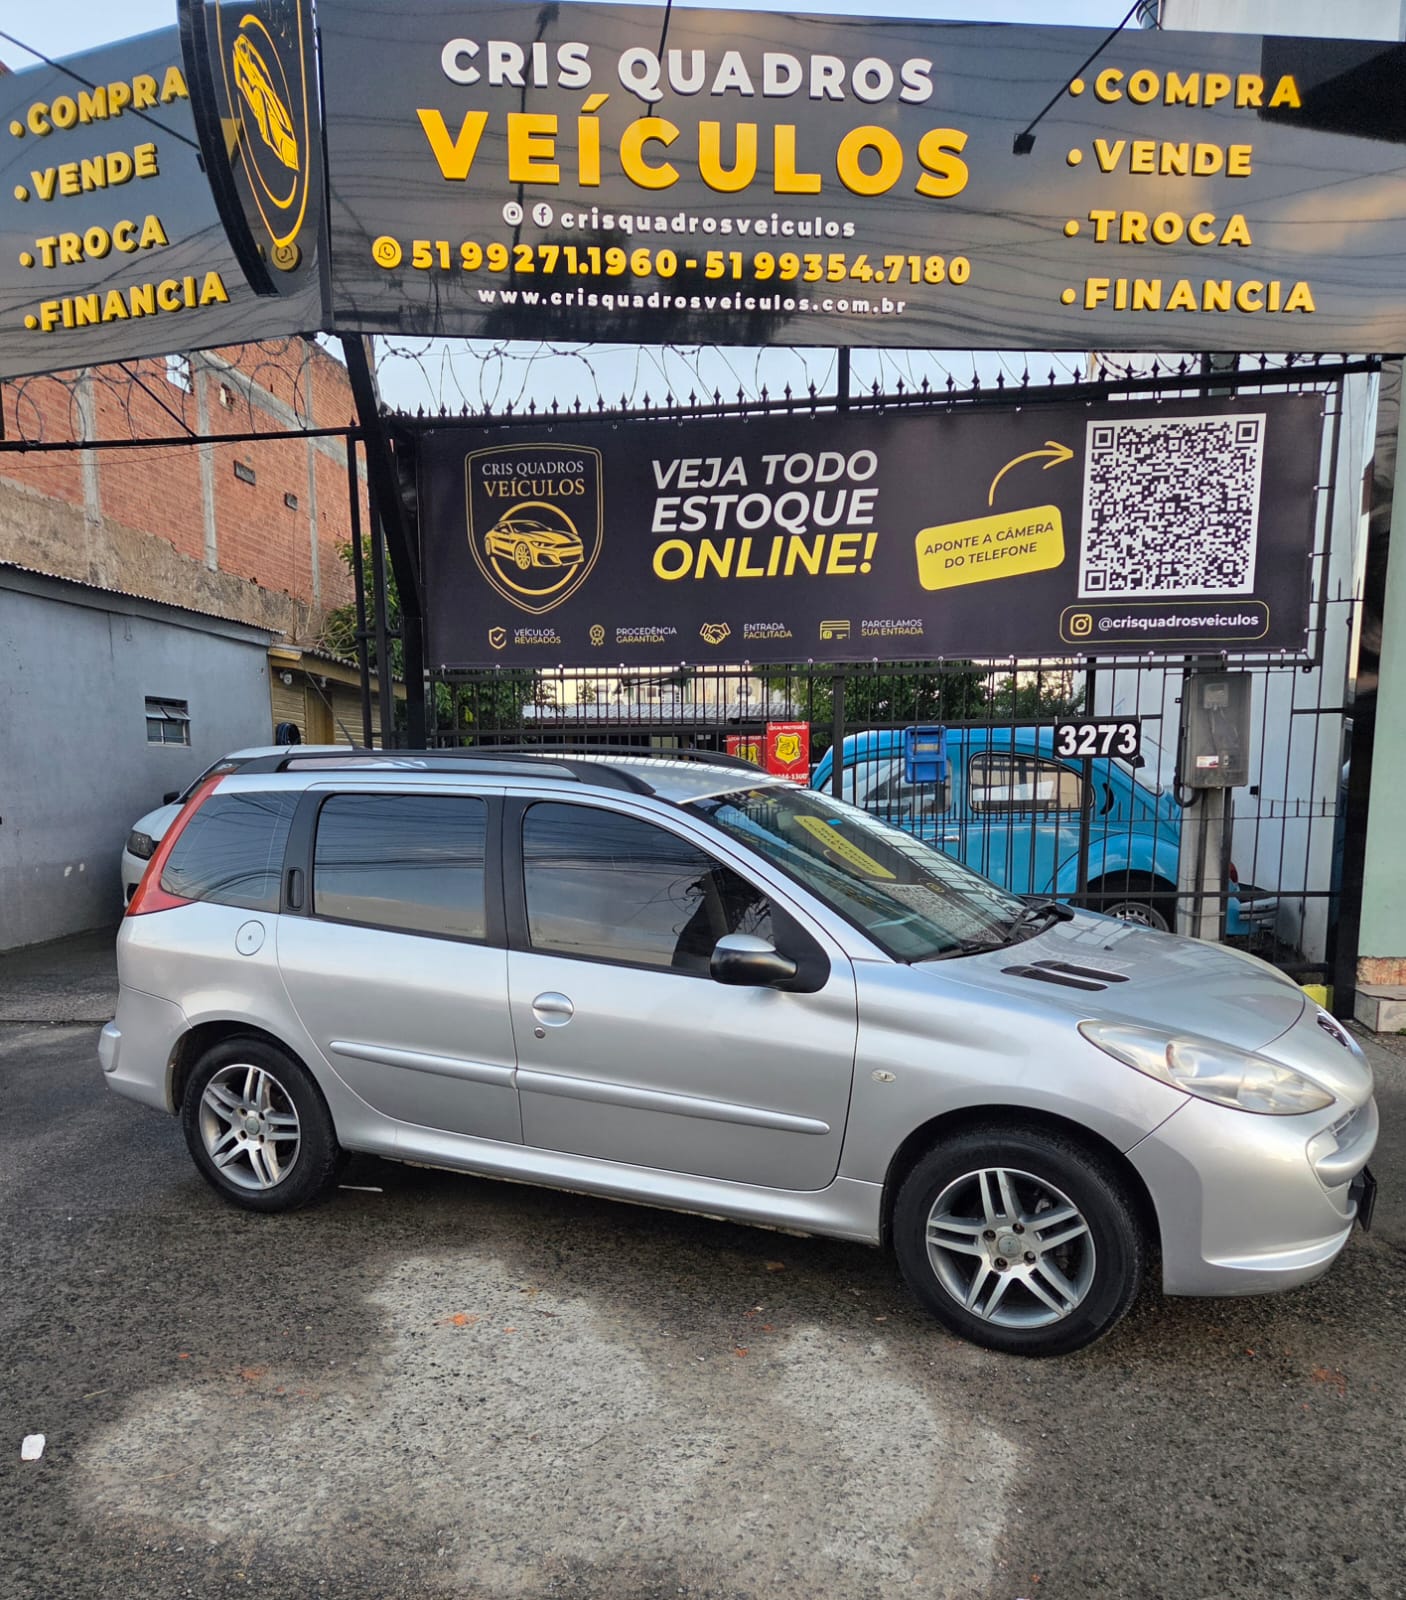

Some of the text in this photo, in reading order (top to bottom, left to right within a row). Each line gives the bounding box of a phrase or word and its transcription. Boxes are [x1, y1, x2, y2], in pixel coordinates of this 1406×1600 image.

[441, 38, 935, 104] CRIS QUADROS
[1094, 68, 1302, 108] COMPRA
[27, 66, 189, 137] COMPRA
[416, 93, 970, 198] VEÍCULOS
[1094, 138, 1254, 177] VENDE
[32, 142, 159, 201] VENDE
[560, 207, 856, 239] crisquadrosveiculos
[1089, 209, 1253, 247] TROCA
[37, 214, 168, 269] TROCA
[412, 240, 451, 270] 51
[460, 241, 679, 278] 99271.1960
[704, 250, 743, 279] 51
[753, 252, 971, 285] 99354.7180
[41, 270, 229, 332] FINANCIA
[477, 287, 907, 315] www.crisquadrosveiculos.com.br
[1084, 277, 1317, 313] FINANCIA
[482, 460, 584, 477] CRIS QUADROS
[652, 450, 878, 489] VEJA TODO
[483, 477, 585, 497] VEÍCULOS
[651, 488, 879, 534] ESTOQUE
[924, 521, 1055, 556] APONTE A CÂMERA
[944, 541, 1038, 569] DO TELEFONE
[652, 532, 878, 580] ONLINE!
[514, 628, 555, 637] VEÍCULOS
[616, 625, 677, 636] PROCEDÊNCIA
[616, 635, 665, 644] GARANTIDA
[744, 622, 785, 632] ENTRADA
[744, 630, 793, 640] FACILITADA
[861, 619, 923, 628] PARCELAMOS
[861, 627, 924, 637] SUA ENTRADA
[1098, 613, 1260, 632] @crisquadrosveiculos
[515, 636, 561, 645] REVISADOS
[1058, 723, 1137, 756] 3273
